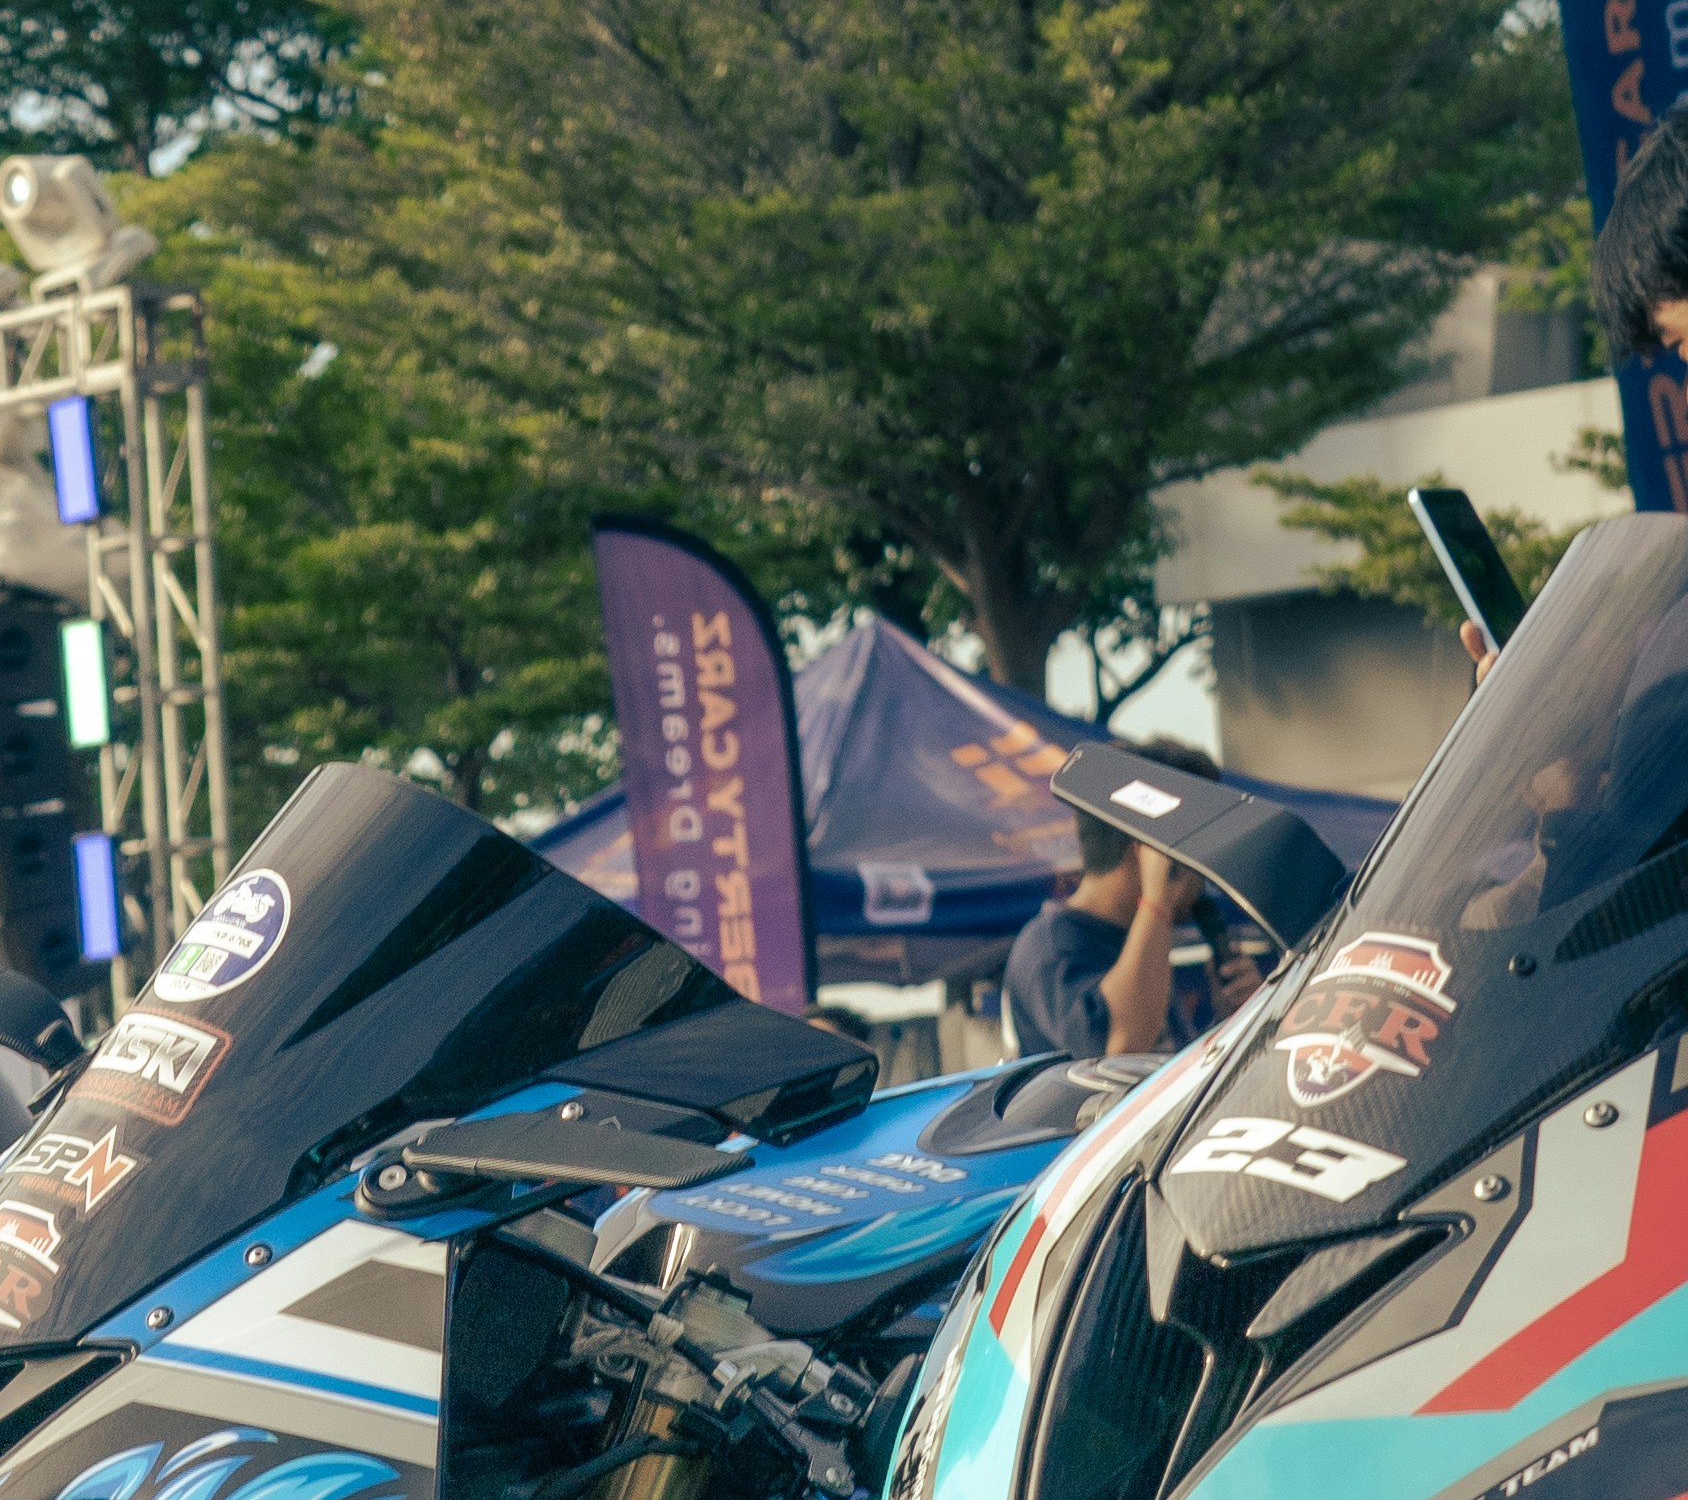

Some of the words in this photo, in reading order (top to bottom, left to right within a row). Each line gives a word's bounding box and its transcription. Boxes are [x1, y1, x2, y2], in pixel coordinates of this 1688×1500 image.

[1283, 990, 1439, 1065] CFR
[4, 1124, 137, 1213] SPN
[1170, 1116, 1408, 1203] 23
[1499, 1426, 1599, 1497] TEAM
